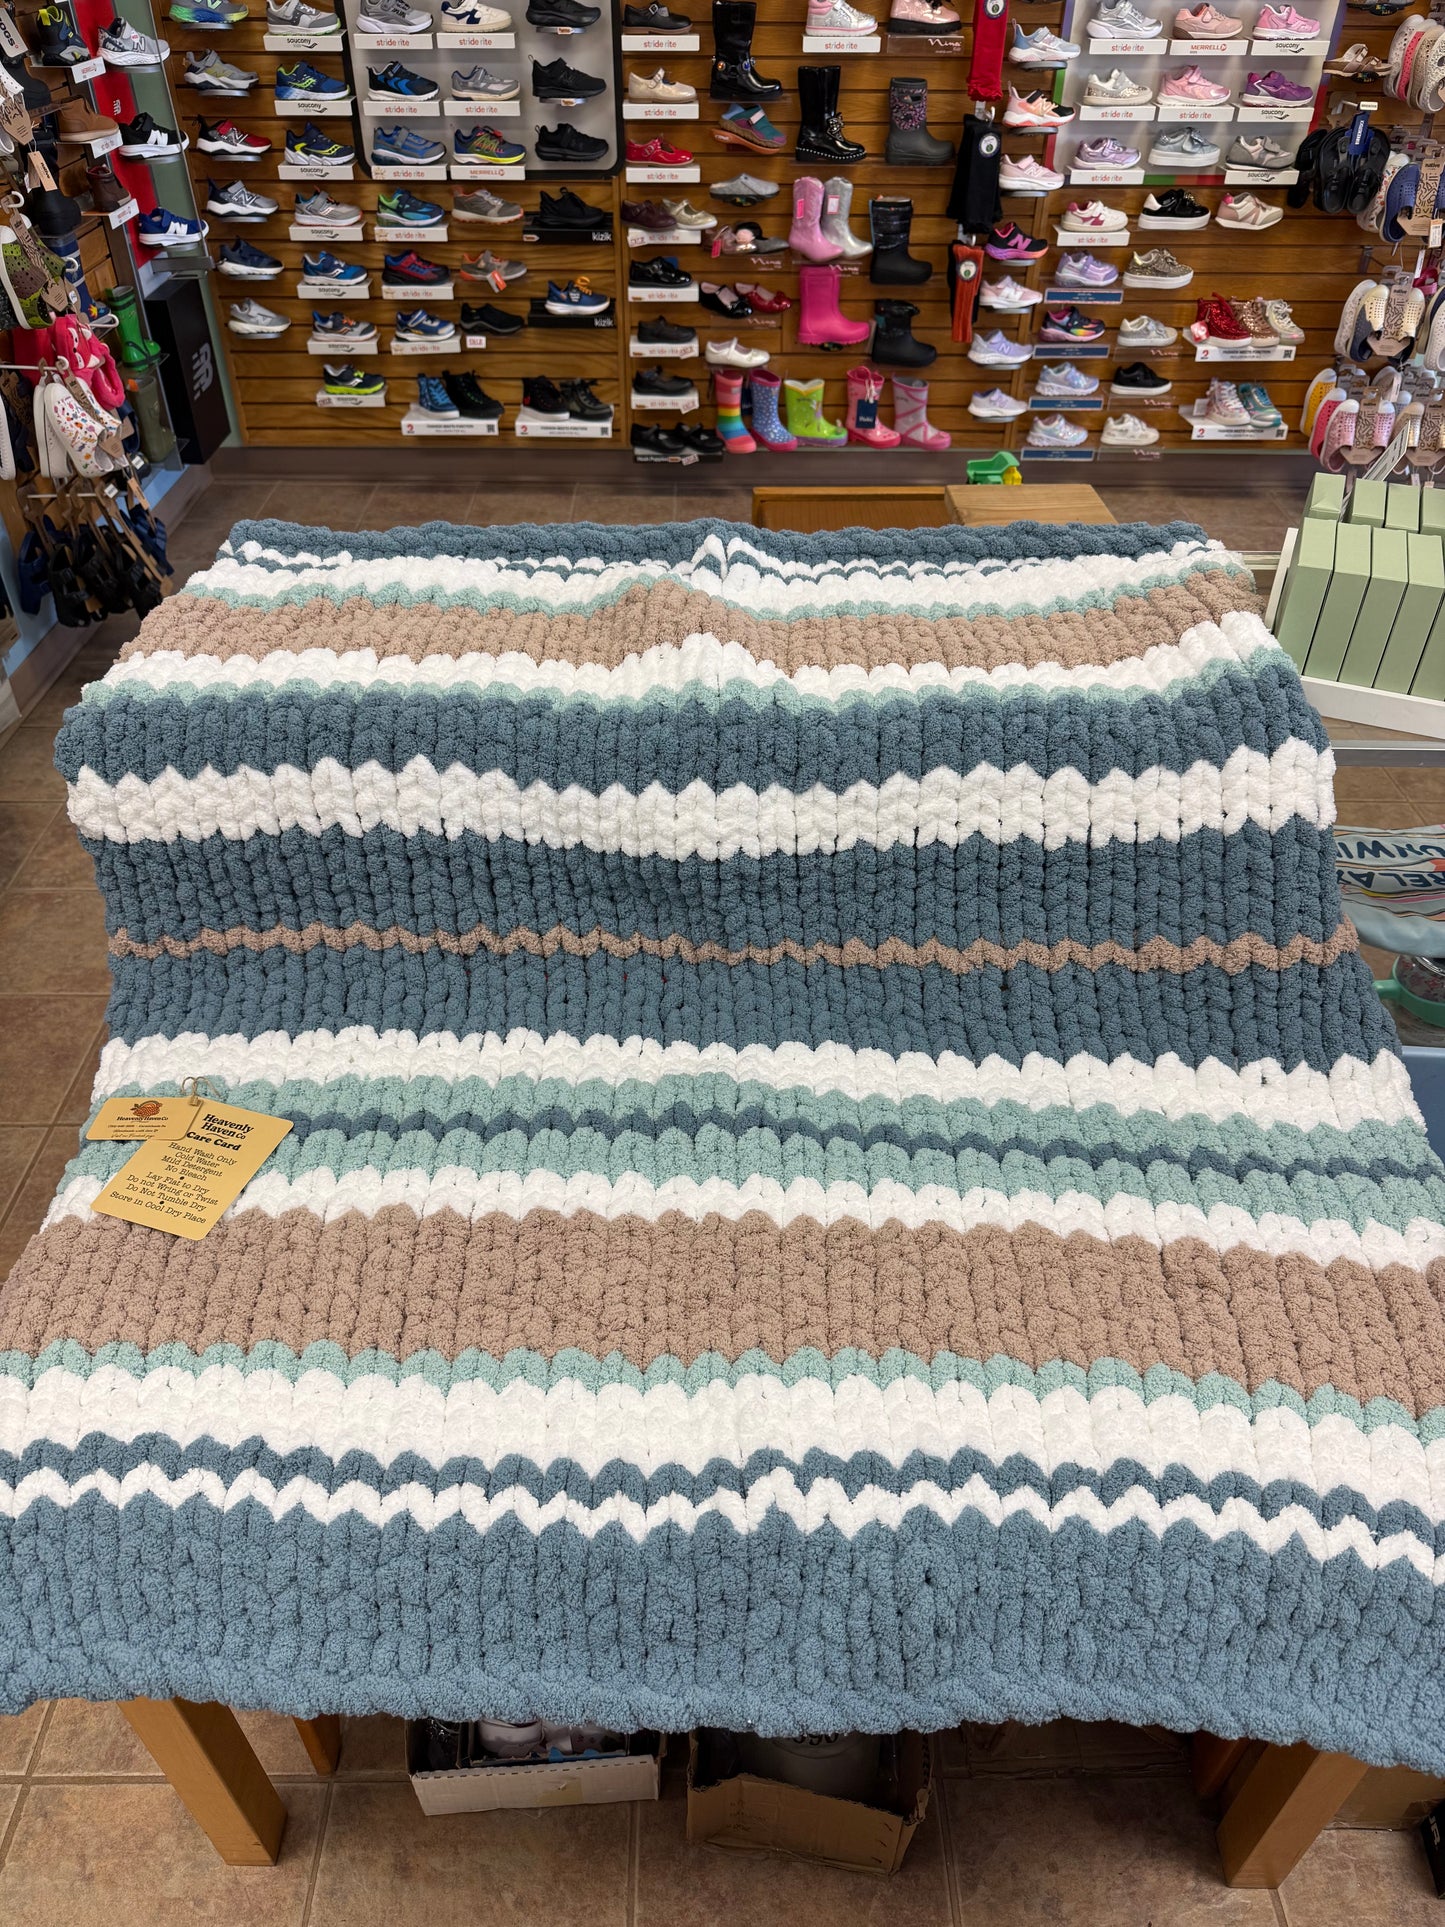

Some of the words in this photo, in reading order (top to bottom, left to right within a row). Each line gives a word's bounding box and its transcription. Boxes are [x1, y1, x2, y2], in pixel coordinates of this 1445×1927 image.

[592, 232, 611, 241] kizik
[201, 1122, 235, 1137] Haven
[203, 1114, 254, 1133] Heavenly
[186, 1132, 212, 1143] Care
[214, 1139, 241, 1150] Card
[168, 1142, 192, 1153] Hand
[194, 1149, 215, 1159] Wash
[217, 1156, 237, 1166] Only
[175, 1152, 195, 1161] Cold
[196, 1157, 219, 1168] Water
[162, 1156, 181, 1165] Mild
[182, 1161, 223, 1177] Detergent
[180, 1169, 207, 1180] Bleach
[140, 1179, 154, 1187] not
[157, 1183, 183, 1196] Wring
[196, 1194, 219, 1205] Twist
[146, 1172, 162, 1181] Lay
[164, 1177, 180, 1186] Flat
[194, 1185, 210, 1194] Dry
[110, 1191, 132, 1202] Store
[145, 1202, 165, 1211] Cool
[165, 1207, 182, 1217] Dry
[183, 1212, 206, 1223] Place
[140, 1188, 156, 1196] Not
[158, 1192, 189, 1206] Tumble
[189, 1202, 206, 1212] Dry
